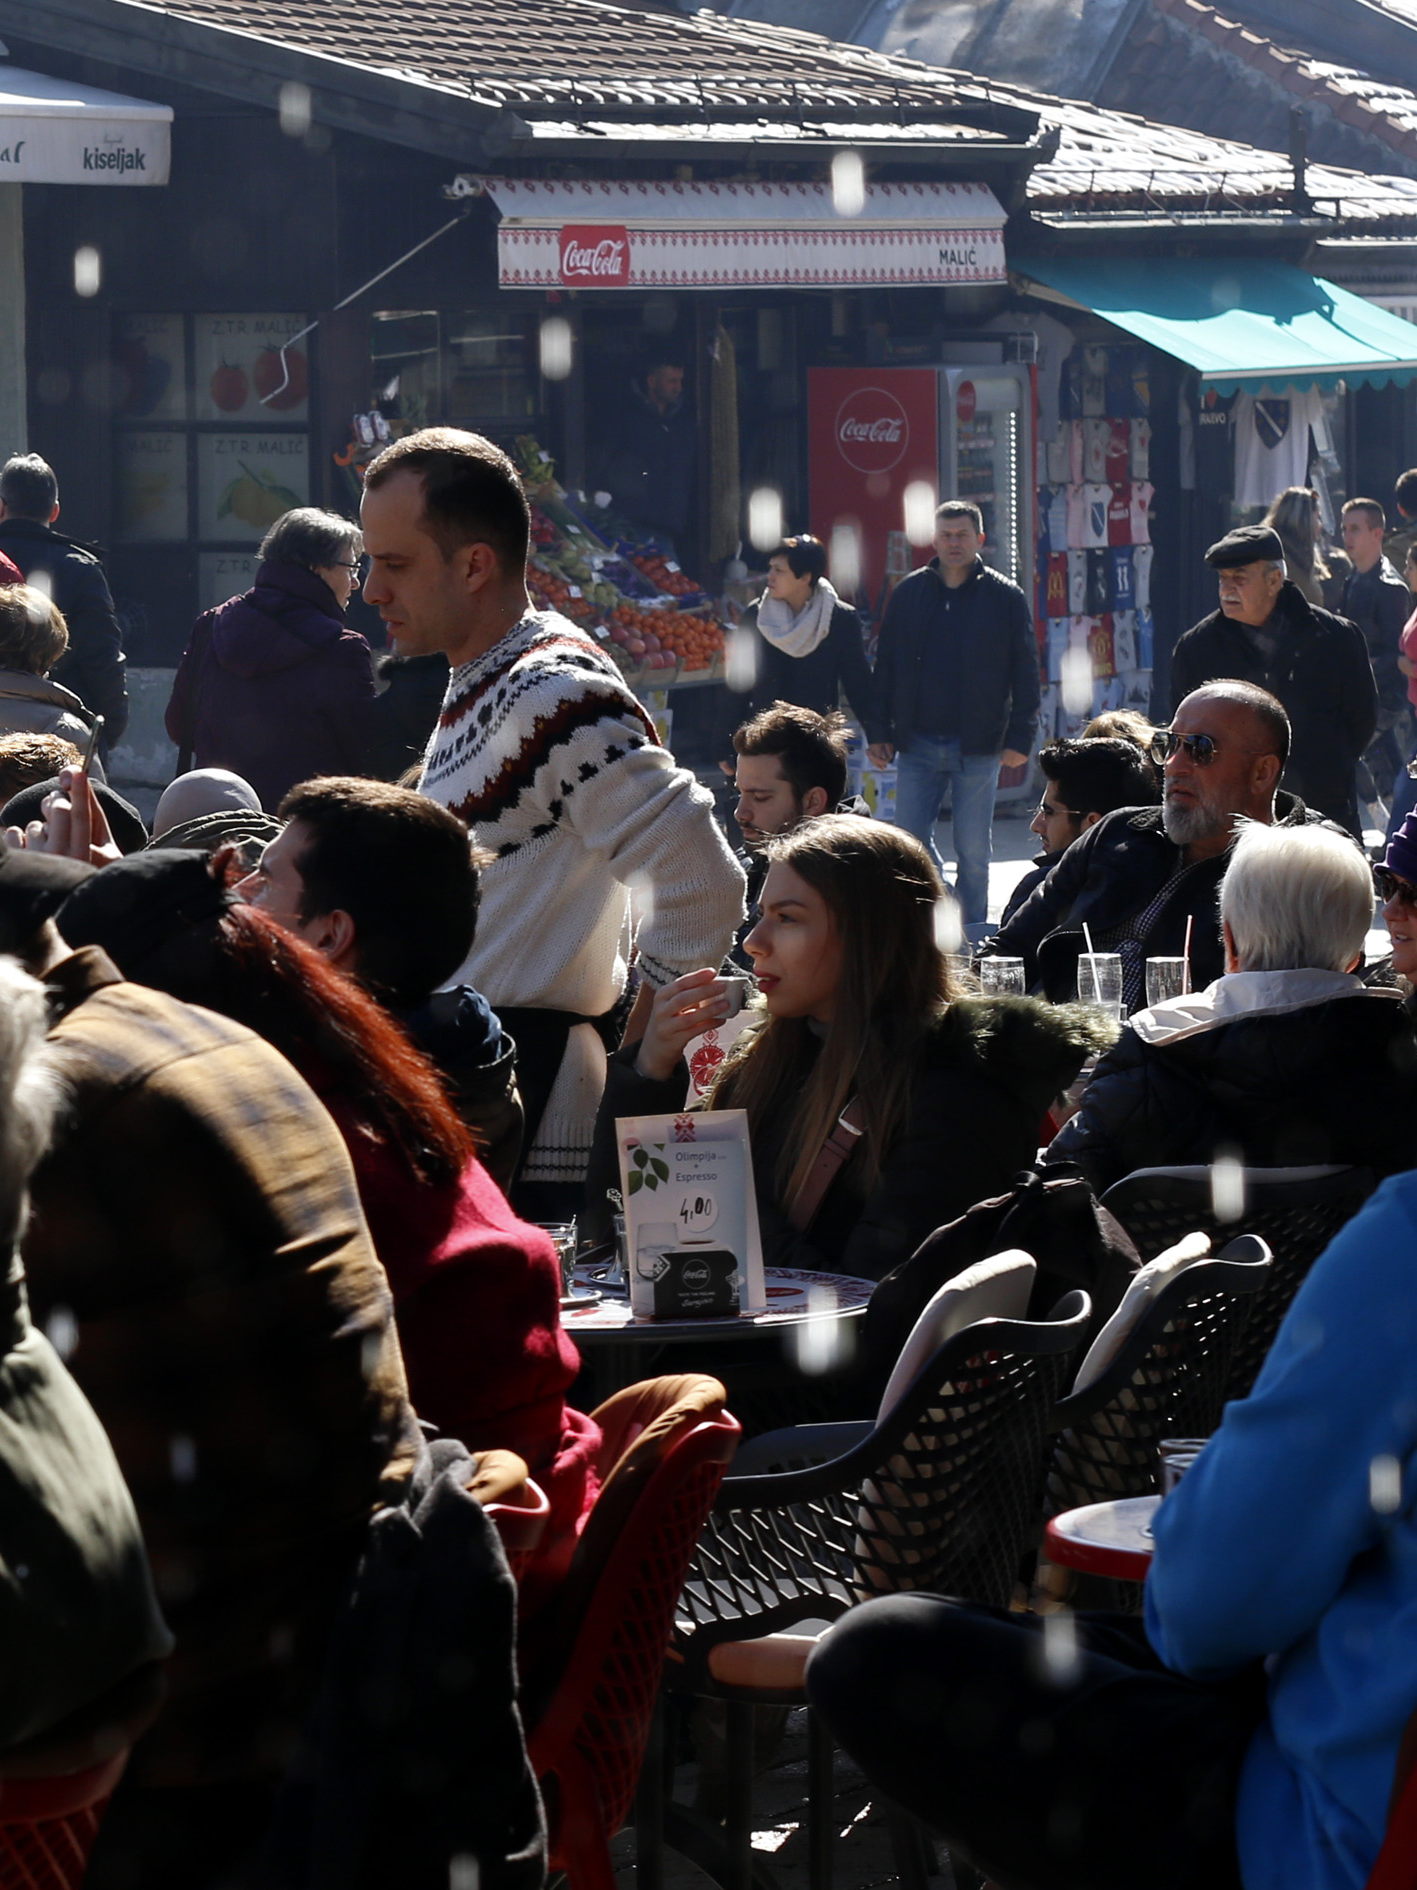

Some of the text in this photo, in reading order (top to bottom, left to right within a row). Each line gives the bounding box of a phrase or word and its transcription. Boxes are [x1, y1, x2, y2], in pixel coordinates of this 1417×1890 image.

[83, 146, 146, 175] kiseljak
[563, 239, 625, 277] Coca-Cola
[939, 245, 977, 266] MALIĆ
[839, 417, 904, 443] Coca-Cola
[675, 1151, 717, 1163] Olimpija
[675, 1172, 718, 1183] Espresso
